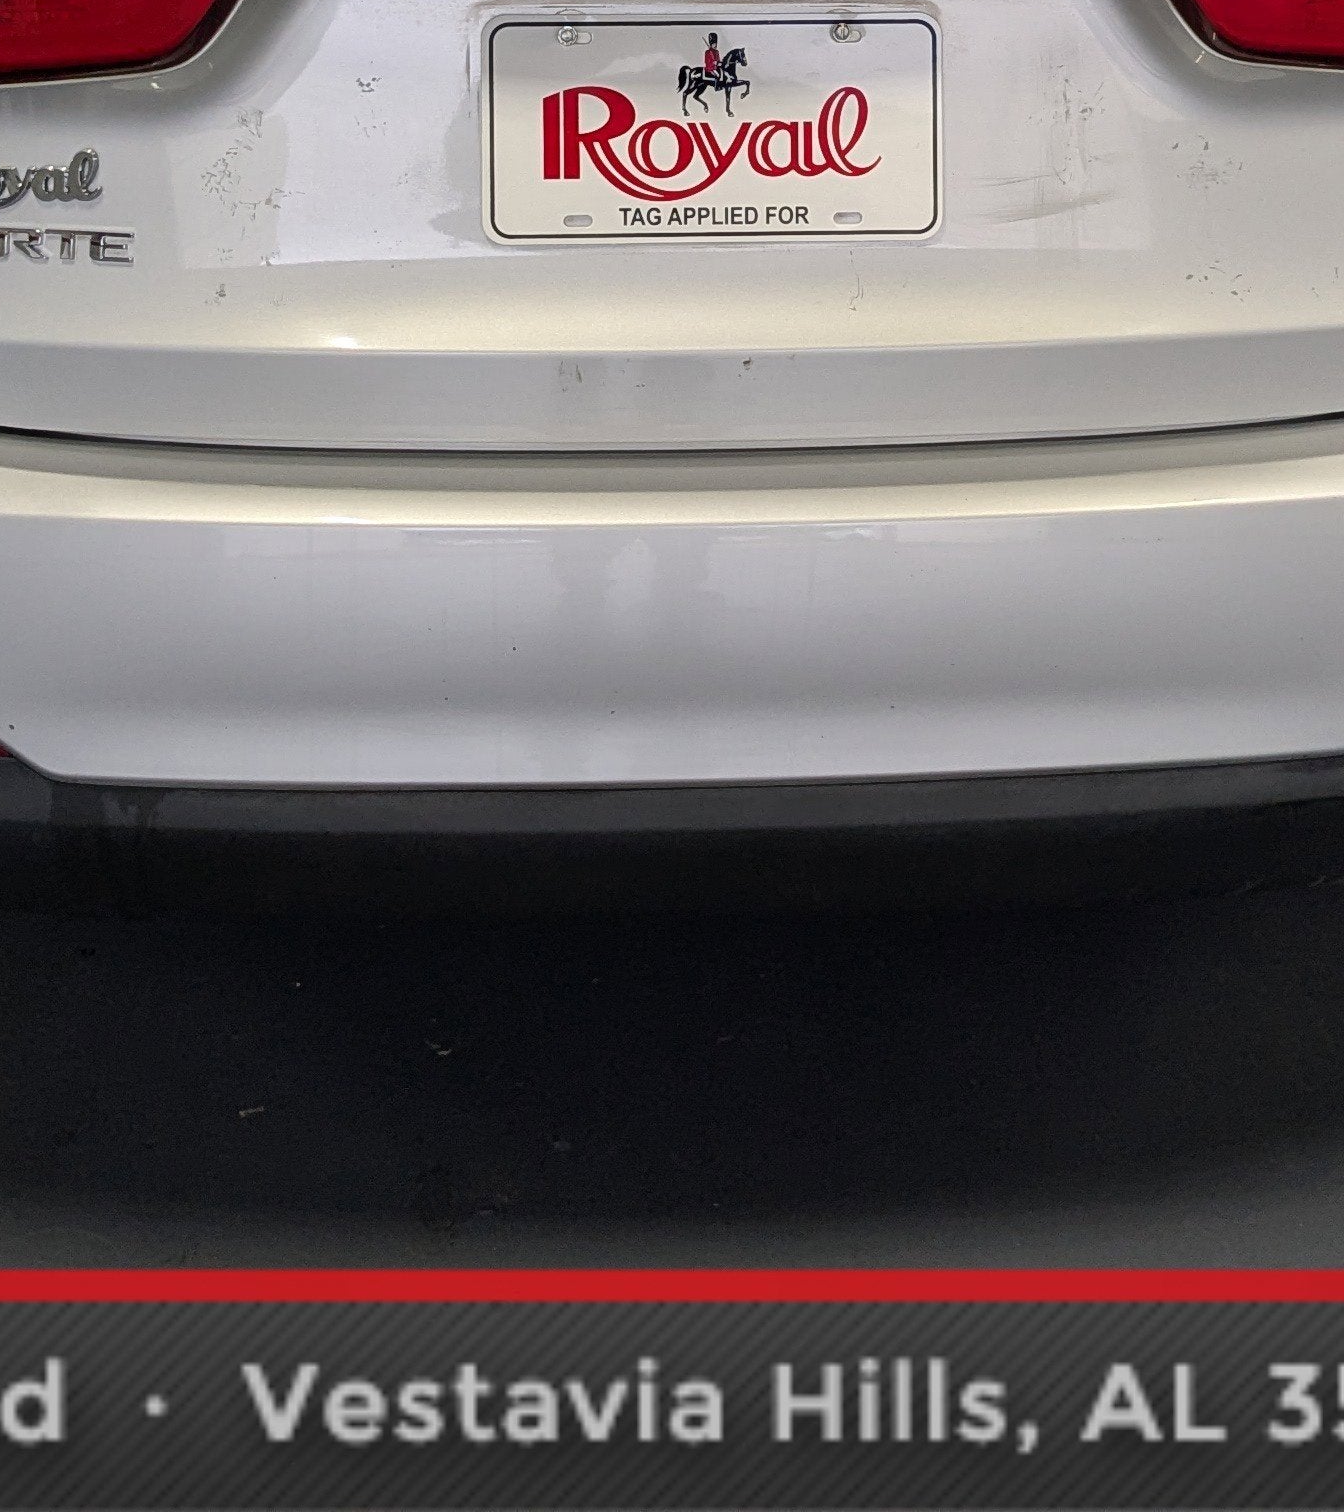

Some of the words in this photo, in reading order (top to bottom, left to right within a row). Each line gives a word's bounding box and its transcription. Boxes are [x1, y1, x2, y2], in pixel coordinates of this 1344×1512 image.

[542, 86, 882, 202] Royal
[618, 207, 662, 226] TAG
[667, 206, 759, 226] APPLIED
[765, 206, 810, 225] FOR
